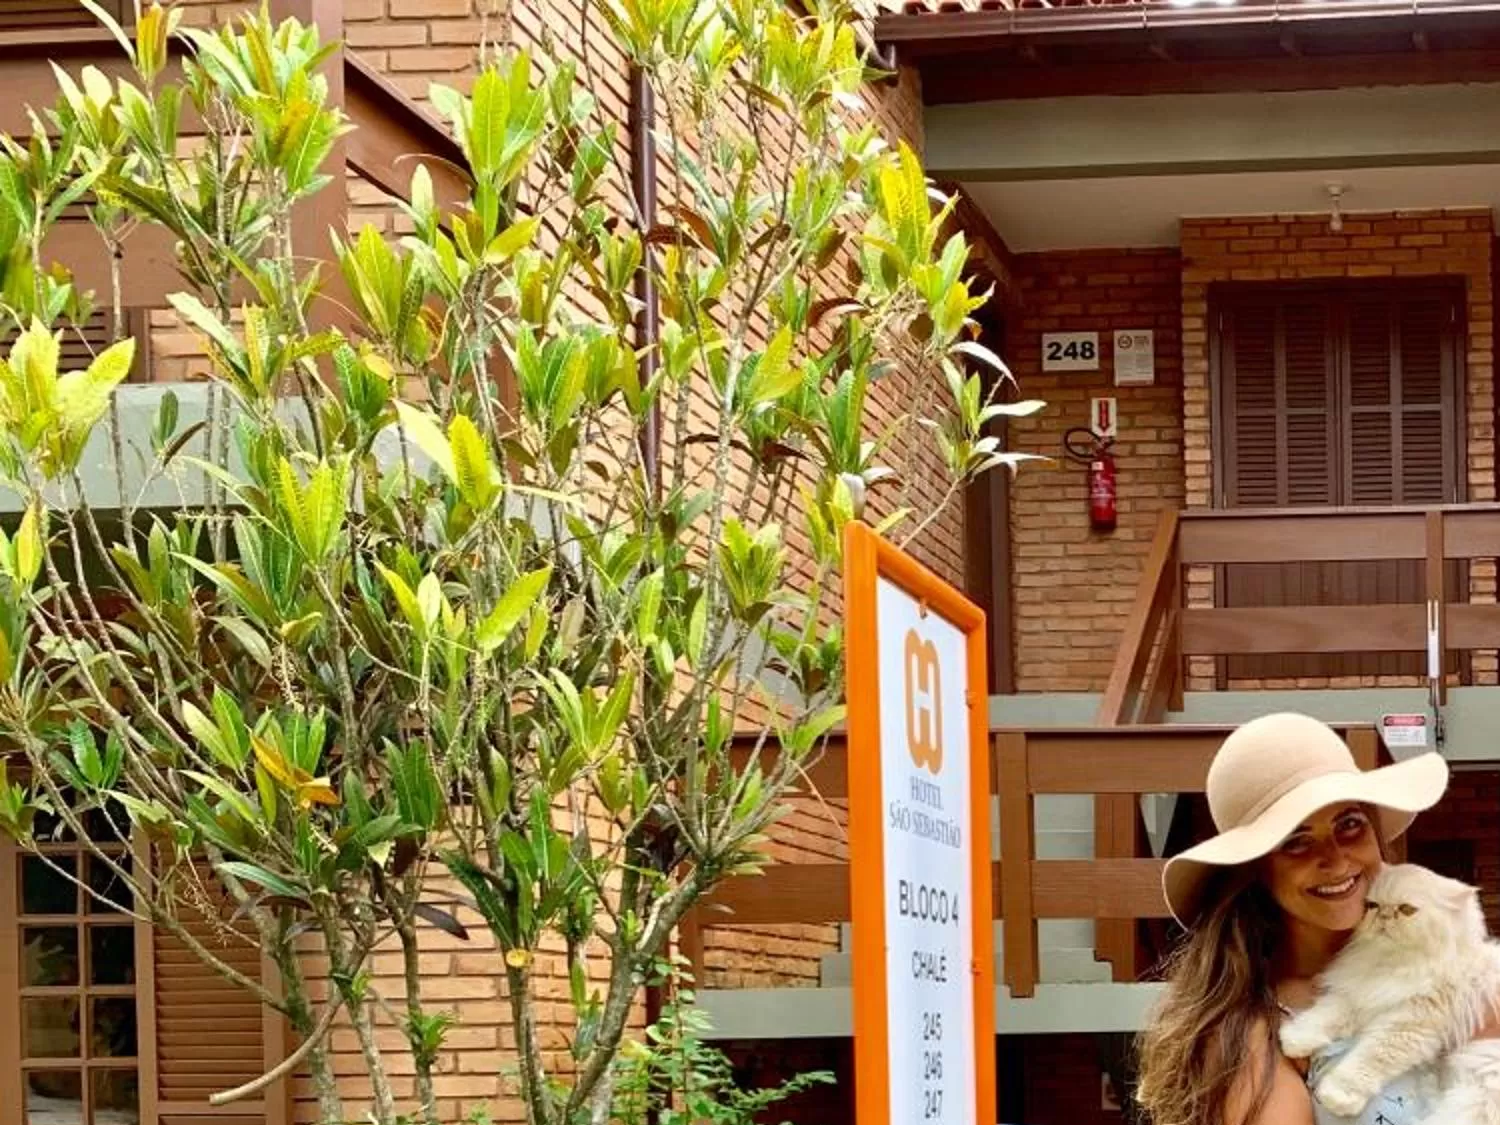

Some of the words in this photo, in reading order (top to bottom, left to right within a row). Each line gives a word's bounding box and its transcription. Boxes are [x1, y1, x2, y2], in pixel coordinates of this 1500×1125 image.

[1046, 341, 1095, 361] 248
[910, 776, 943, 810] HOTEL
[889, 800, 910, 834] SÃO
[911, 811, 961, 849] SEBASTIÃO
[899, 880, 949, 924] BLOCO
[950, 893, 960, 927] 4
[912, 946, 948, 983] CHALÉ
[923, 1013, 942, 1041] 245
[924, 1052, 942, 1080] 246
[925, 1090, 943, 1119] 247
